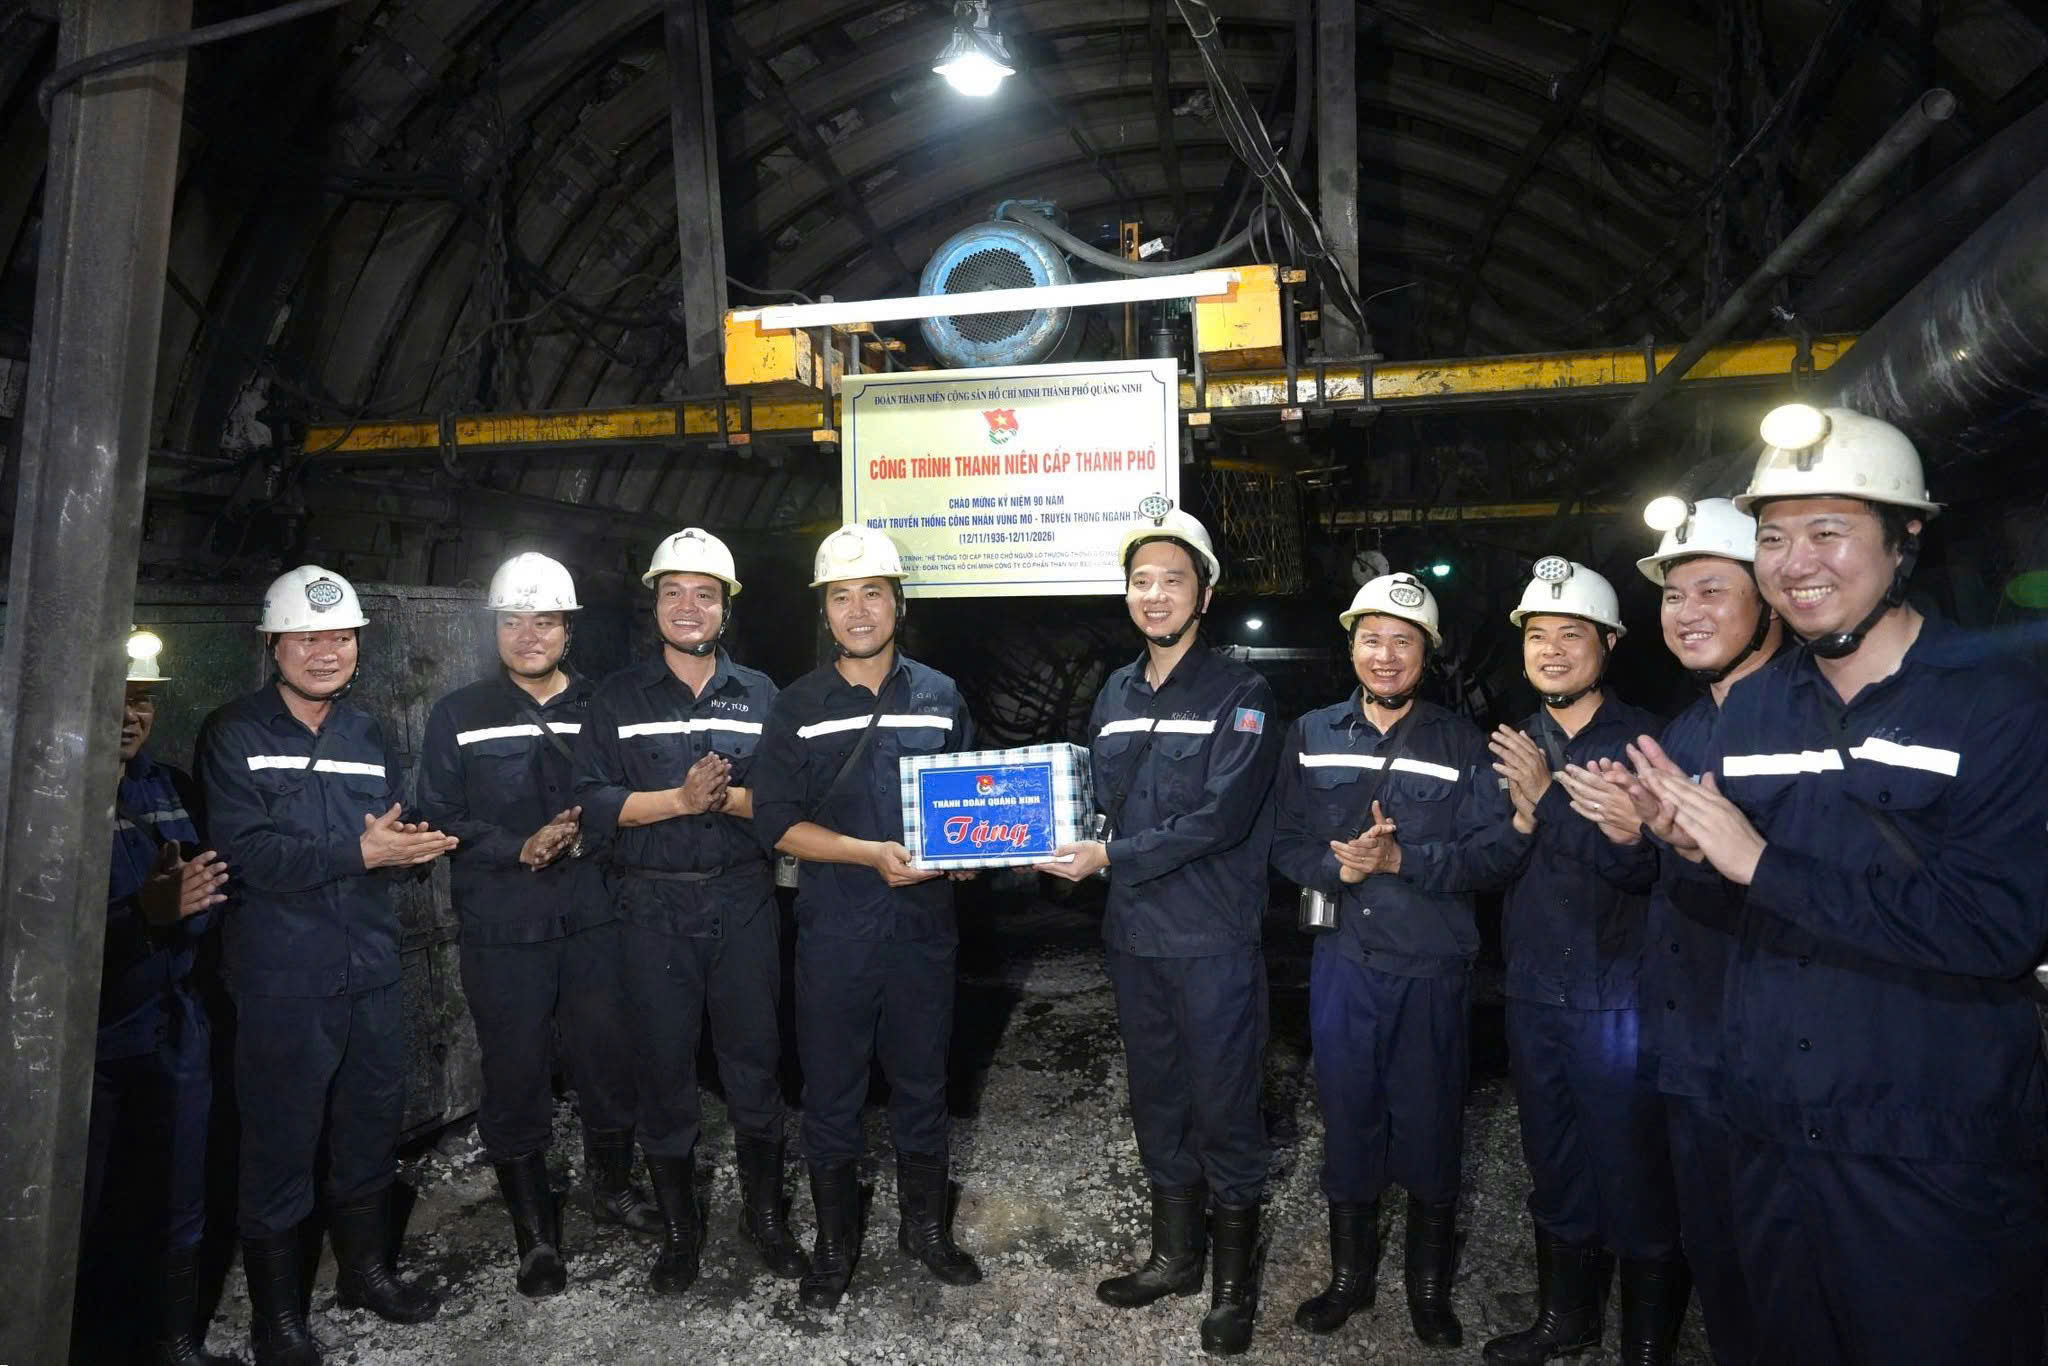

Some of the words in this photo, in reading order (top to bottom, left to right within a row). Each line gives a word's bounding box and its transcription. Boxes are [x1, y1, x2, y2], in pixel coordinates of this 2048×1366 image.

[874, 393, 896, 405] ĐOÀN
[898, 393, 925, 405] THANH
[926, 391, 945, 403] NIÊN
[947, 390, 970, 403] CỘNG
[971, 388, 987, 401] SẢN
[988, 386, 1001, 400] HỒ
[1002, 387, 1017, 399] CHÍ
[1018, 388, 1040, 398] MINH
[1042, 385, 1070, 397] THÀNH
[1071, 382, 1089, 396] PHỐ
[1090, 382, 1120, 396] QUẢNG
[1122, 384, 1143, 394] NINH
[870, 456, 907, 480] CÔNG
[911, 453, 951, 478] TRÌNH
[955, 455, 1001, 477] THANH
[1004, 449, 1038, 475] NIÊN
[1043, 445, 1071, 473] CẤP
[1075, 448, 1122, 473] THÀNH
[1127, 442, 1156, 471] PHỐ
[948, 496, 970, 509] CHÀO
[972, 496, 996, 509] MỪNG
[1010, 494, 1032, 507] NIỆM
[1033, 496, 1043, 506] 90
[1045, 494, 1065, 505] NĂM
[867, 516, 887, 529] NGÀY
[890, 515, 919, 529] TRUYỀN
[921, 513, 946, 527] THỐNG
[948, 514, 970, 527] CÔNG
[972, 513, 994, 526] NHÂN
[996, 513, 1018, 525] VÙNG
[1020, 510, 1033, 524] MỎ
[1040, 511, 1071, 523] TRUYỀN
[1073, 510, 1100, 522] THỐNG
[1102, 510, 1131, 522] NGÀNH
[959, 531, 1055, 544] (12/11/1936-12/11/2026)
[932, 799, 961, 808] THÀNH
[962, 798, 985, 808] ĐOÀN
[988, 796, 1017, 807] QUẢNG
[1018, 796, 1041, 805] NINH
[943, 815, 1031, 848] Tặng
